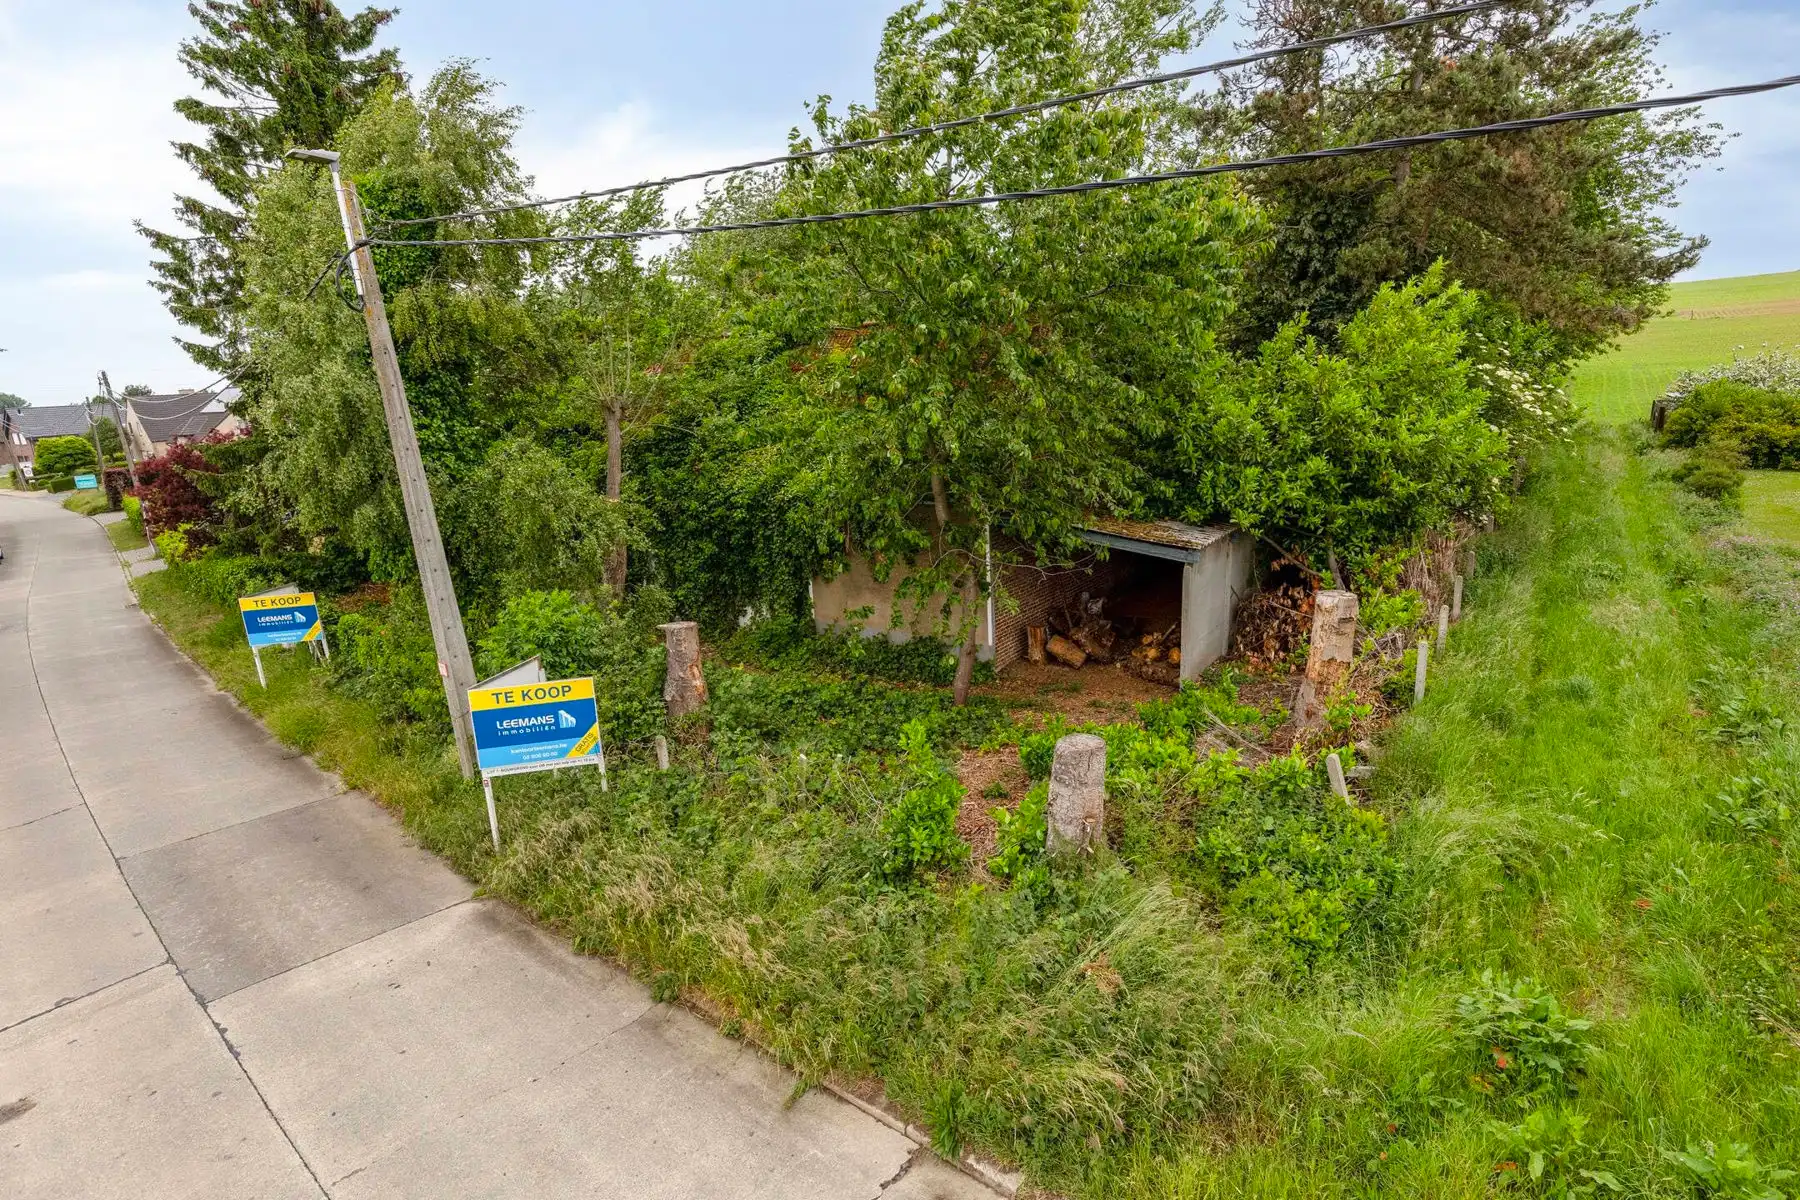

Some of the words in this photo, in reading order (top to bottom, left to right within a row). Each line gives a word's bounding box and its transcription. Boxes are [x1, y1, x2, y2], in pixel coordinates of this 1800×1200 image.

[253, 600, 268, 608] TE
[271, 597, 301, 606] KOOP
[257, 614, 293, 623] LEEMANS
[492, 691, 515, 704] TE
[521, 685, 572, 701] KOOP
[496, 715, 555, 729] LEEMANS
[498, 726, 556, 736] immobiliën
